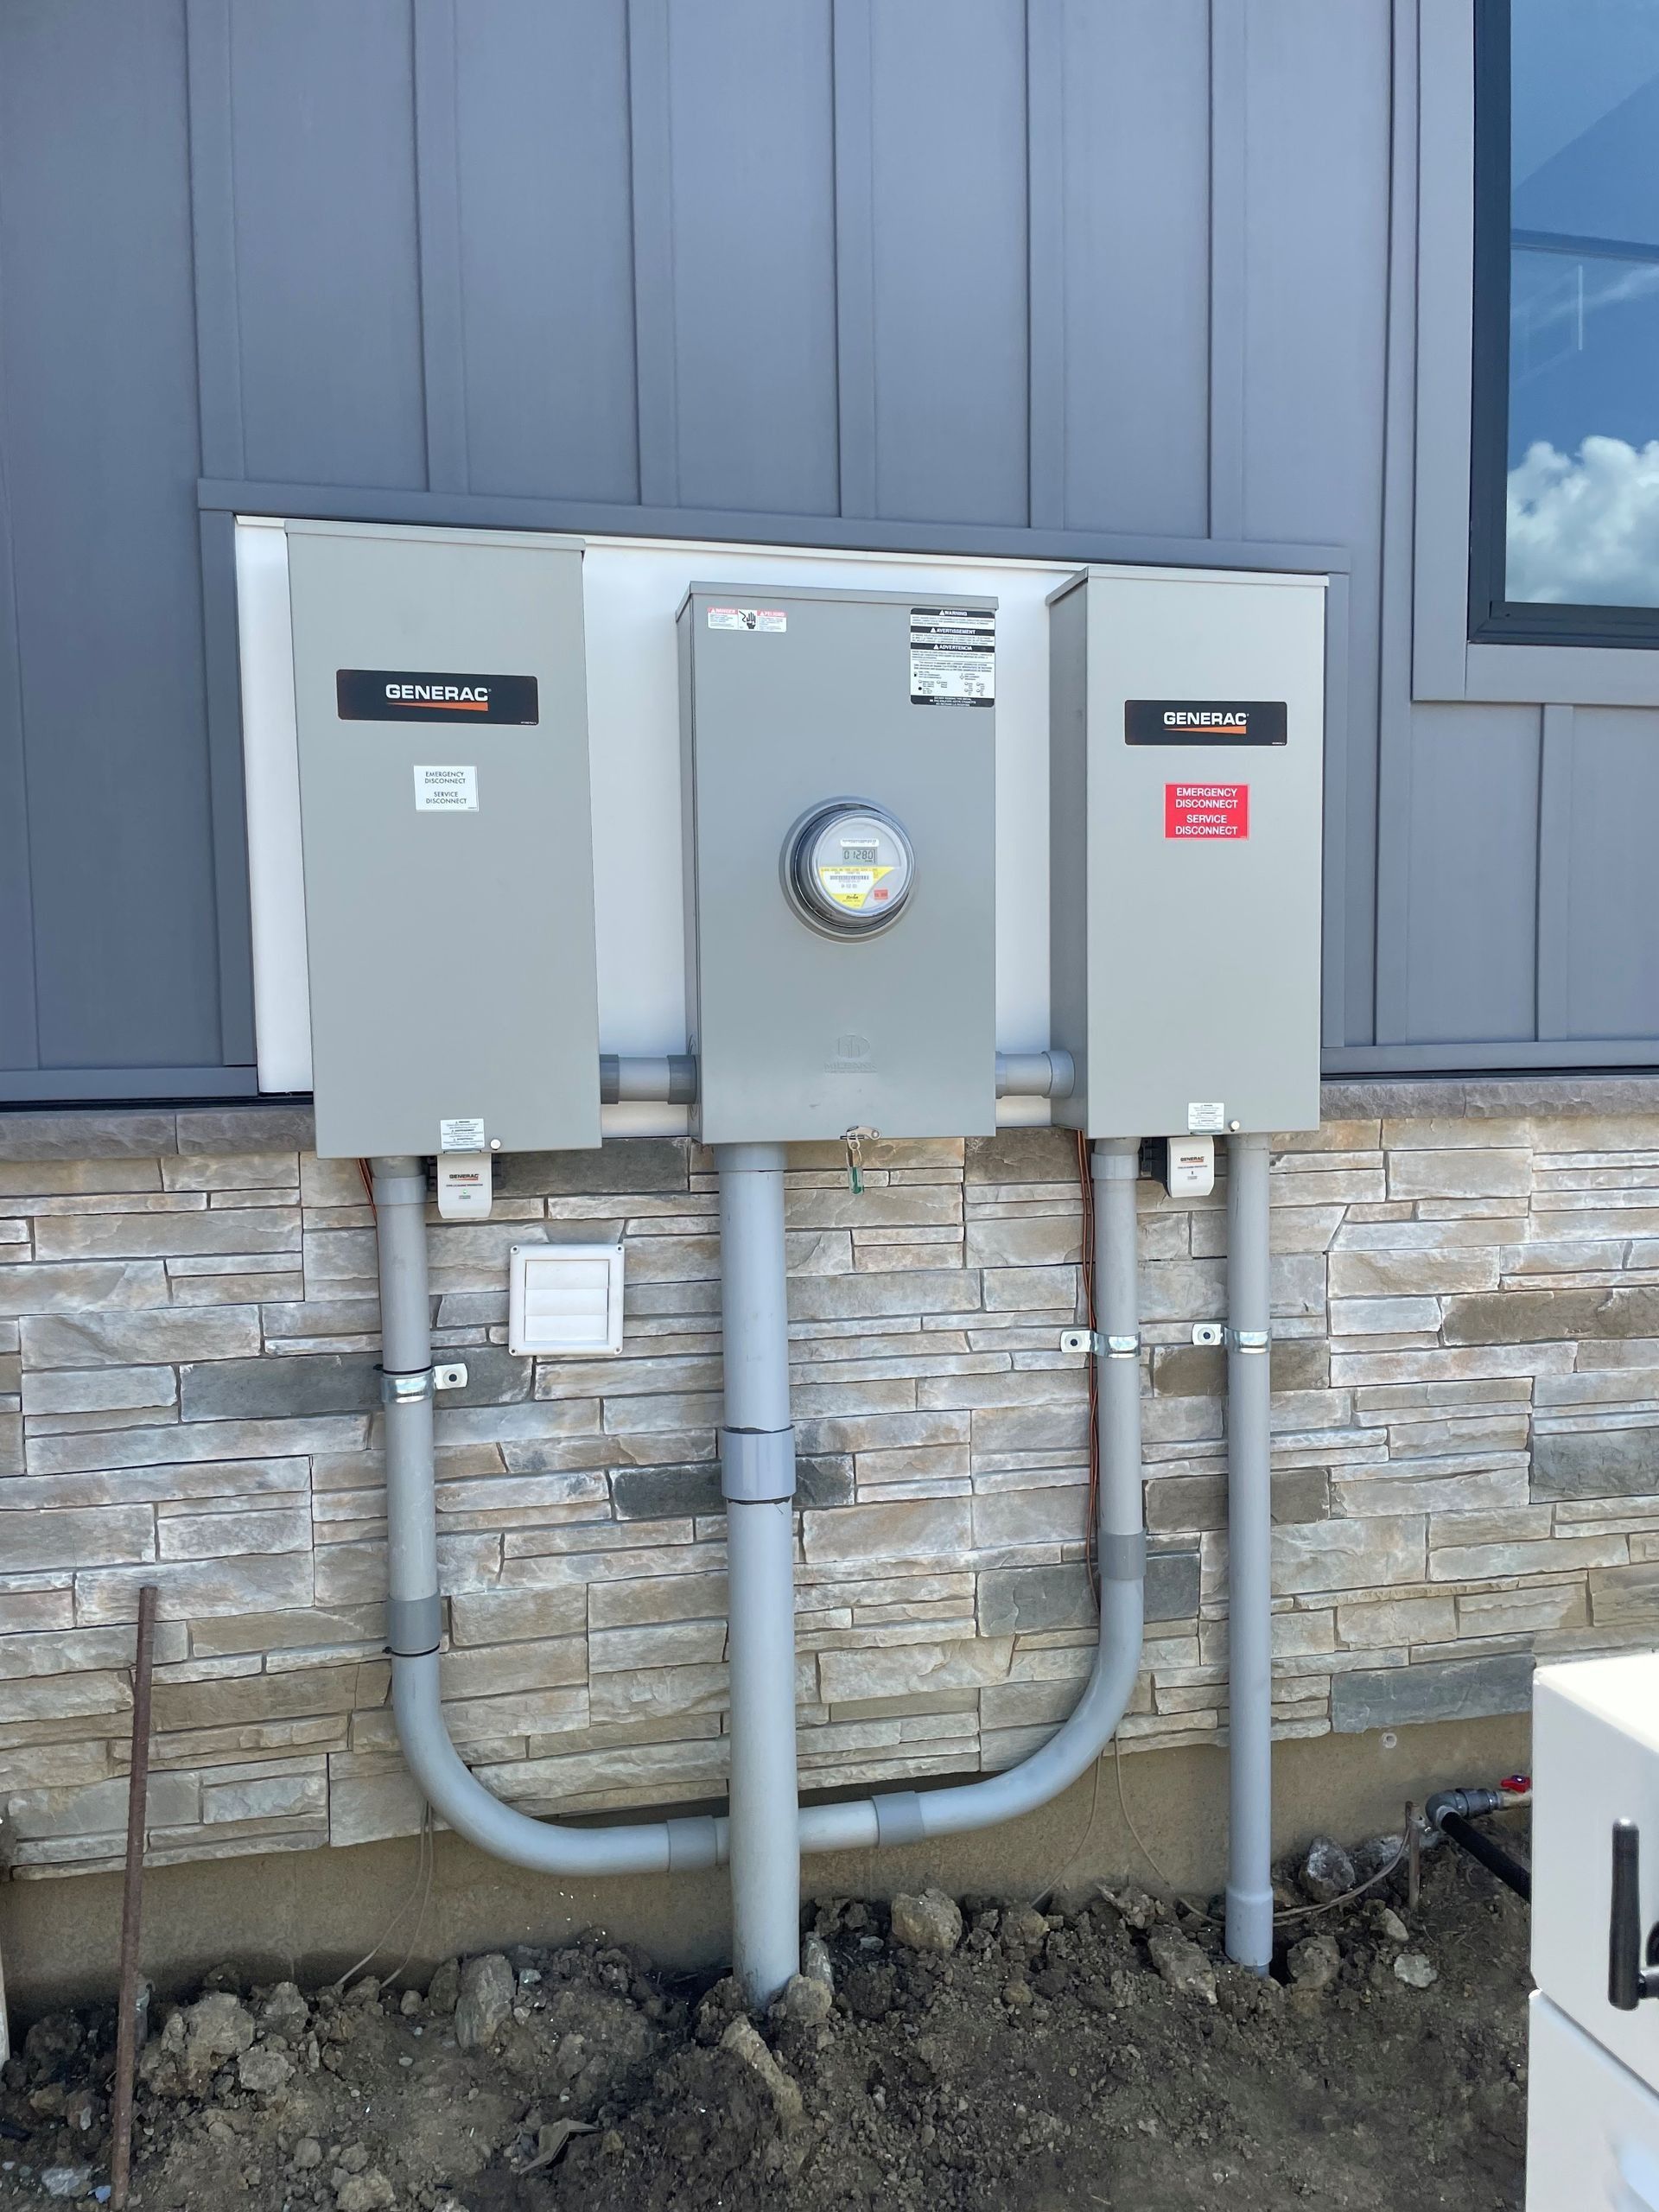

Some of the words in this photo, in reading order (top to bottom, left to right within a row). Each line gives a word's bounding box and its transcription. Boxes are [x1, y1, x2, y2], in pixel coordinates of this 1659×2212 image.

[385, 683, 489, 702] GENERAC
[1163, 712, 1247, 725] GENERAC
[1176, 787, 1238, 797] EMERGENCY
[1175, 799, 1238, 809] DISCONNECT
[1185, 814, 1228, 823] SERVICE
[1175, 826, 1238, 836] DISCONNECT
